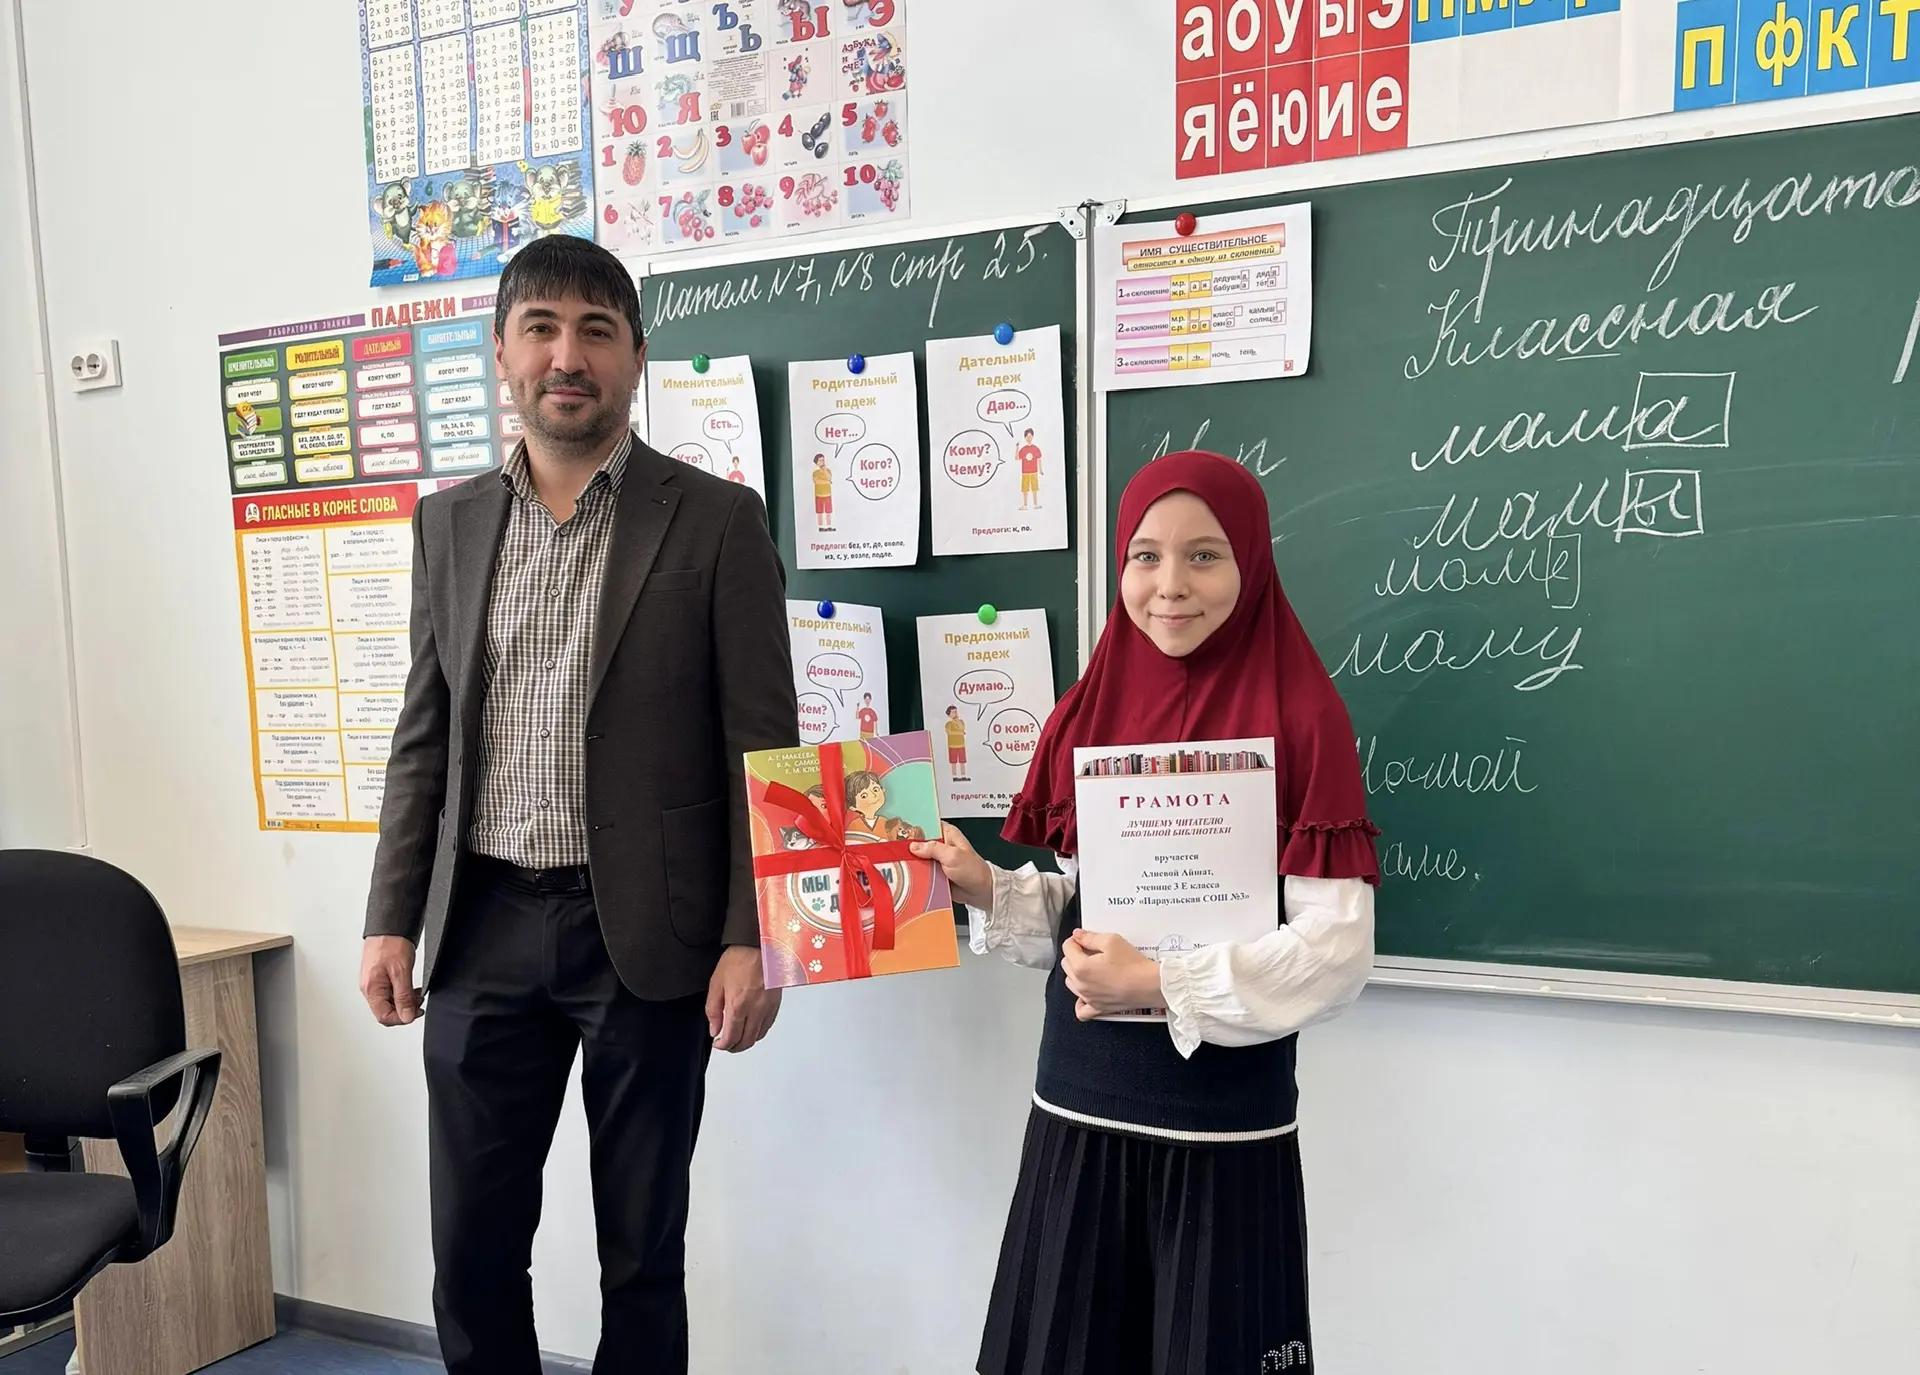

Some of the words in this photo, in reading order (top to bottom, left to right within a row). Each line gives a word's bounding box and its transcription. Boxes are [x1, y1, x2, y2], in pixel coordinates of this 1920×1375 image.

[790, 5, 831, 42] Ы
[1181, 4, 1216, 61] а
[1226, 0, 1262, 53] о
[842, 36, 877, 53] АЗБУКА
[1681, 25, 1725, 90] п
[1755, 1, 1804, 87] ф
[1816, 4, 1860, 71] к
[607, 45, 644, 80] Ш
[676, 91, 702, 125] Я
[842, 102, 858, 127] 5
[610, 104, 647, 138] Ю
[778, 113, 794, 138] 4
[1180, 103, 1216, 161] я
[1228, 81, 1259, 153] ё
[1271, 88, 1308, 147] ю
[1318, 81, 1354, 141] и
[1366, 75, 1403, 132] е
[715, 125, 732, 147] 3
[601, 144, 617, 167] 1
[656, 135, 674, 158] 2
[843, 164, 877, 187] 10
[718, 185, 735, 207] 8
[779, 176, 795, 199] 9
[603, 204, 619, 224] 6
[658, 195, 673, 218] 7
[1140, 248, 1162, 257] ИМЯ
[1169, 233, 1268, 255] СУЩЕСТВИТЕЛЬНОЕ
[1133, 258, 1177, 269] относится
[1187, 255, 1216, 264] одному
[1230, 245, 1276, 259] склонений
[371, 296, 457, 328] ПАДЕЖИ
[268, 321, 318, 337] ЛАБОРАТОРИЯ
[322, 315, 351, 330] ЗНАНИЙ
[1404, 281, 1820, 380] Классная
[294, 345, 340, 364] РОДИТЕЛЬНЫЙ
[959, 348, 1036, 372] Дательный
[662, 373, 744, 389] Именительный
[812, 371, 898, 392] Родительный
[976, 371, 1021, 388] падеж
[691, 396, 728, 408] падеж
[835, 396, 876, 410] падеж
[986, 399, 1027, 415] Даю...
[710, 419, 740, 430] Есть...
[825, 427, 859, 438] Нет...
[1410, 385, 1723, 472] мама
[949, 443, 991, 458] Кому?
[860, 457, 893, 470] Кого?
[949, 462, 992, 476] Чему?
[860, 476, 894, 488] Чего?
[262, 502, 311, 521] ГЛАСНЫЕ
[313, 502, 321, 517] В
[323, 499, 357, 516] КОРНЕ
[360, 496, 398, 514] СЛОВА
[972, 526, 1012, 536] Предлоги:
[811, 543, 848, 552] Предлоги:
[792, 616, 872, 634] Творительный
[818, 638, 856, 650] падеж
[944, 628, 1030, 646] Предложный
[967, 650, 1010, 662] падеж
[1330, 624, 1585, 692] маму
[958, 681, 1014, 695] Думаю...
[798, 702, 828, 715] Кем?
[993, 724, 1001, 734] О
[1005, 723, 1036, 734] ком?
[994, 741, 1003, 752] О
[1006, 740, 1037, 752] чём?
[782, 752, 816, 760] МАКЕЕВА
[951, 793, 989, 801] Предлоги:
[1119, 793, 1230, 809] ГРАМОТА
[1127, 819, 1174, 828] ЛУЧШЕМУ
[1175, 817, 1224, 827] ЧИТАТЕЛЮ
[1120, 828, 1171, 838] ШКОЛЬНОЙ
[1172, 826, 1232, 836] БИБЛИОТЕКИ
[1154, 853, 1199, 864] вручается
[1141, 868, 1180, 878] Алиевой
[801, 874, 831, 894] МЫ
[1136, 883, 1172, 893] ученице
[1173, 882, 1179, 891] 3
[1190, 881, 1220, 890] класса
[1107, 897, 1137, 906] МБОУ
[1202, 893, 1228, 903] СОШ
